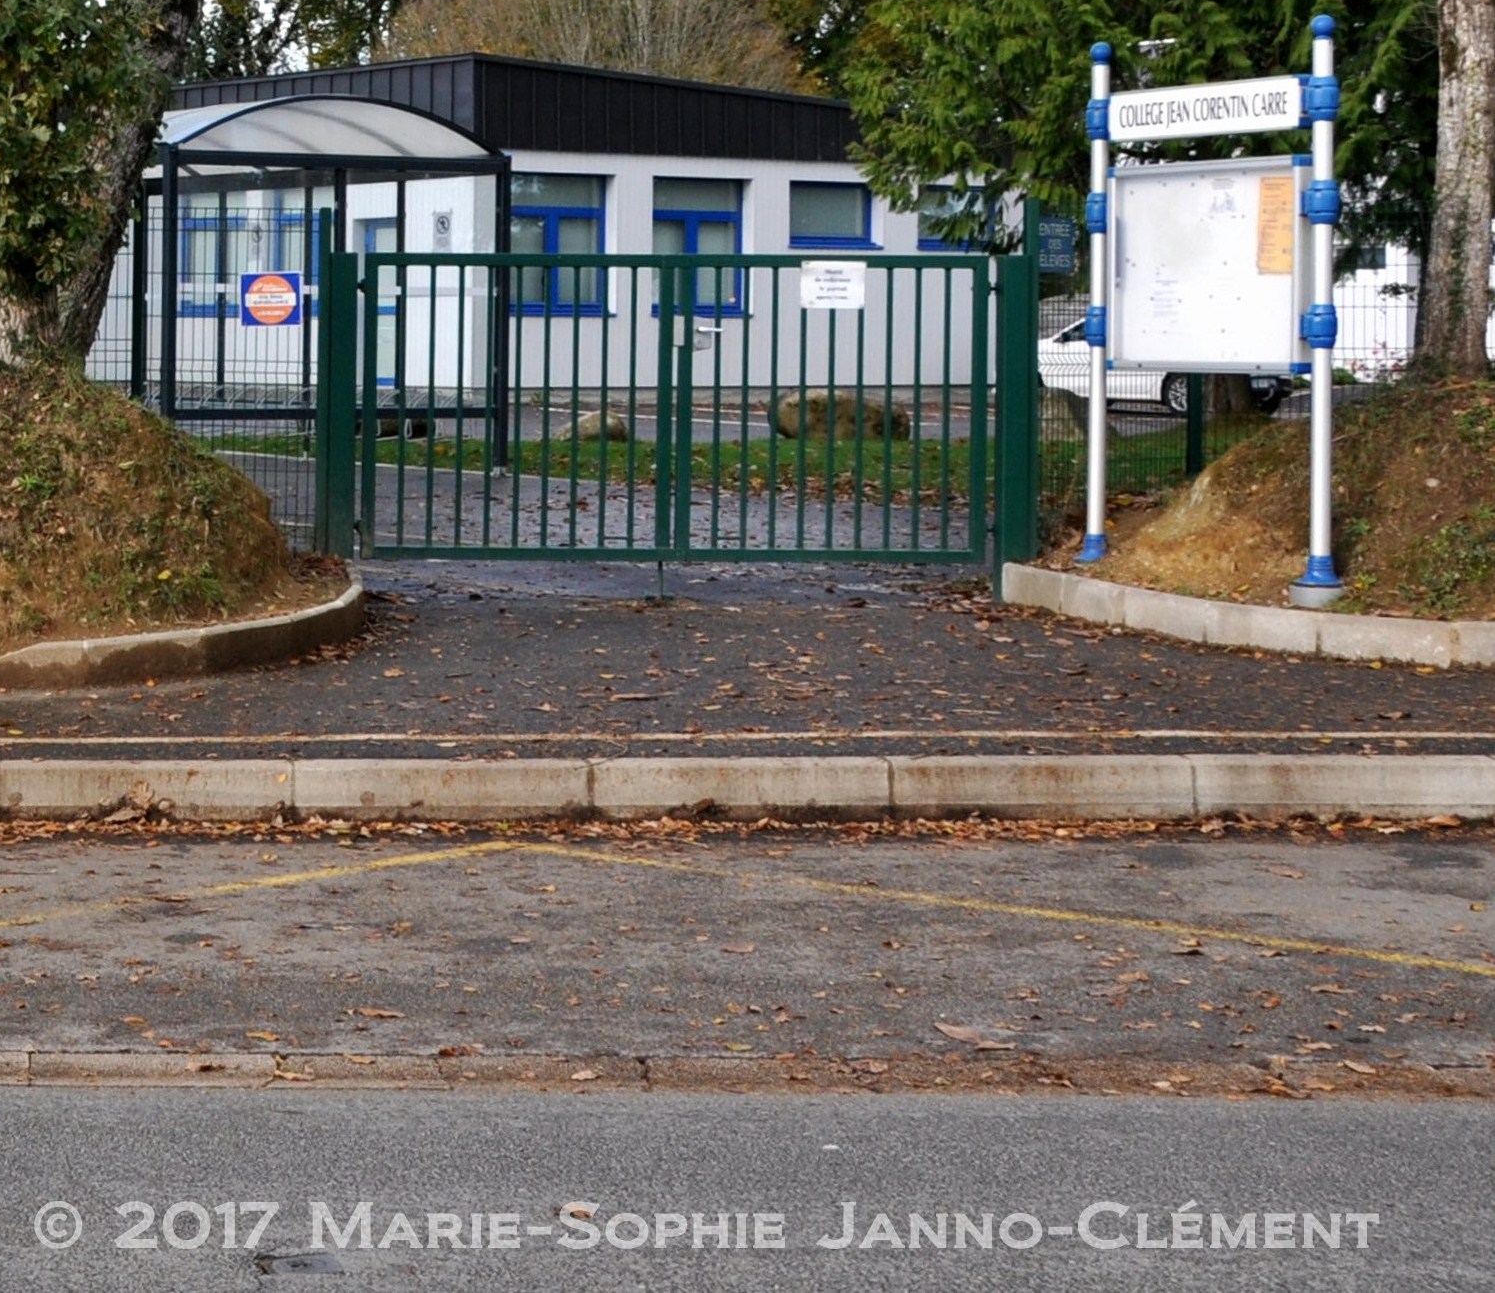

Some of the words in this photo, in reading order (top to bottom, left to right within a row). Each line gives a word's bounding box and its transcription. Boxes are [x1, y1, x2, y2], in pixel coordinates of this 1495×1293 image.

[1119, 102, 1164, 128] COLLEGE
[1166, 100, 1190, 128] JEAN
[1193, 95, 1249, 122] CORENTIN
[1252, 91, 1287, 117] CARRE
